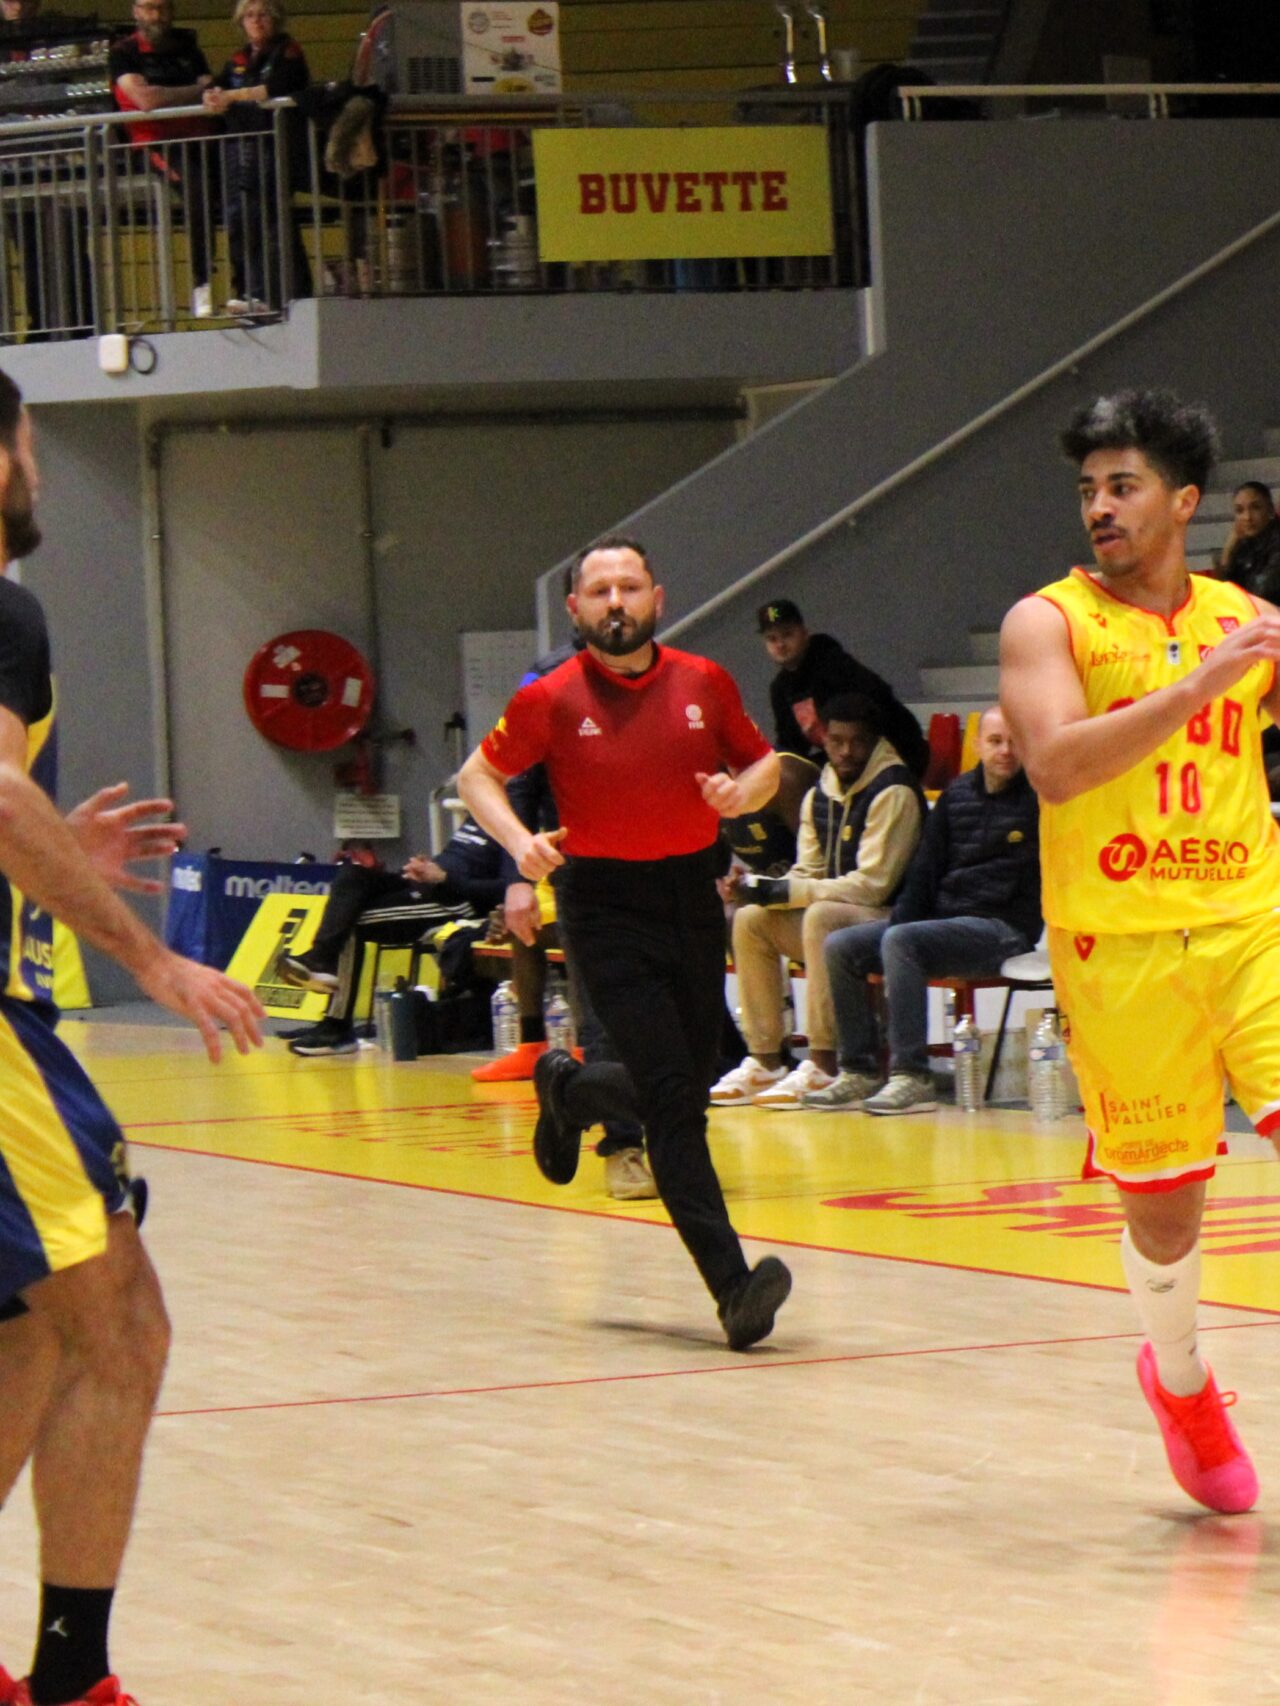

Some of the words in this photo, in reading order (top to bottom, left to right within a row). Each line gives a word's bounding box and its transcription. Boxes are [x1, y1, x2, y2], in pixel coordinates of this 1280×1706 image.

[578, 171, 788, 214] BUVETTE
[1155, 761, 1202, 815] 10
[1150, 866, 1248, 881] MUTUELLE
[224, 875, 334, 899] molten
[1108, 1094, 1161, 1113] SAINT
[1111, 1103, 1187, 1125] VALLIER
